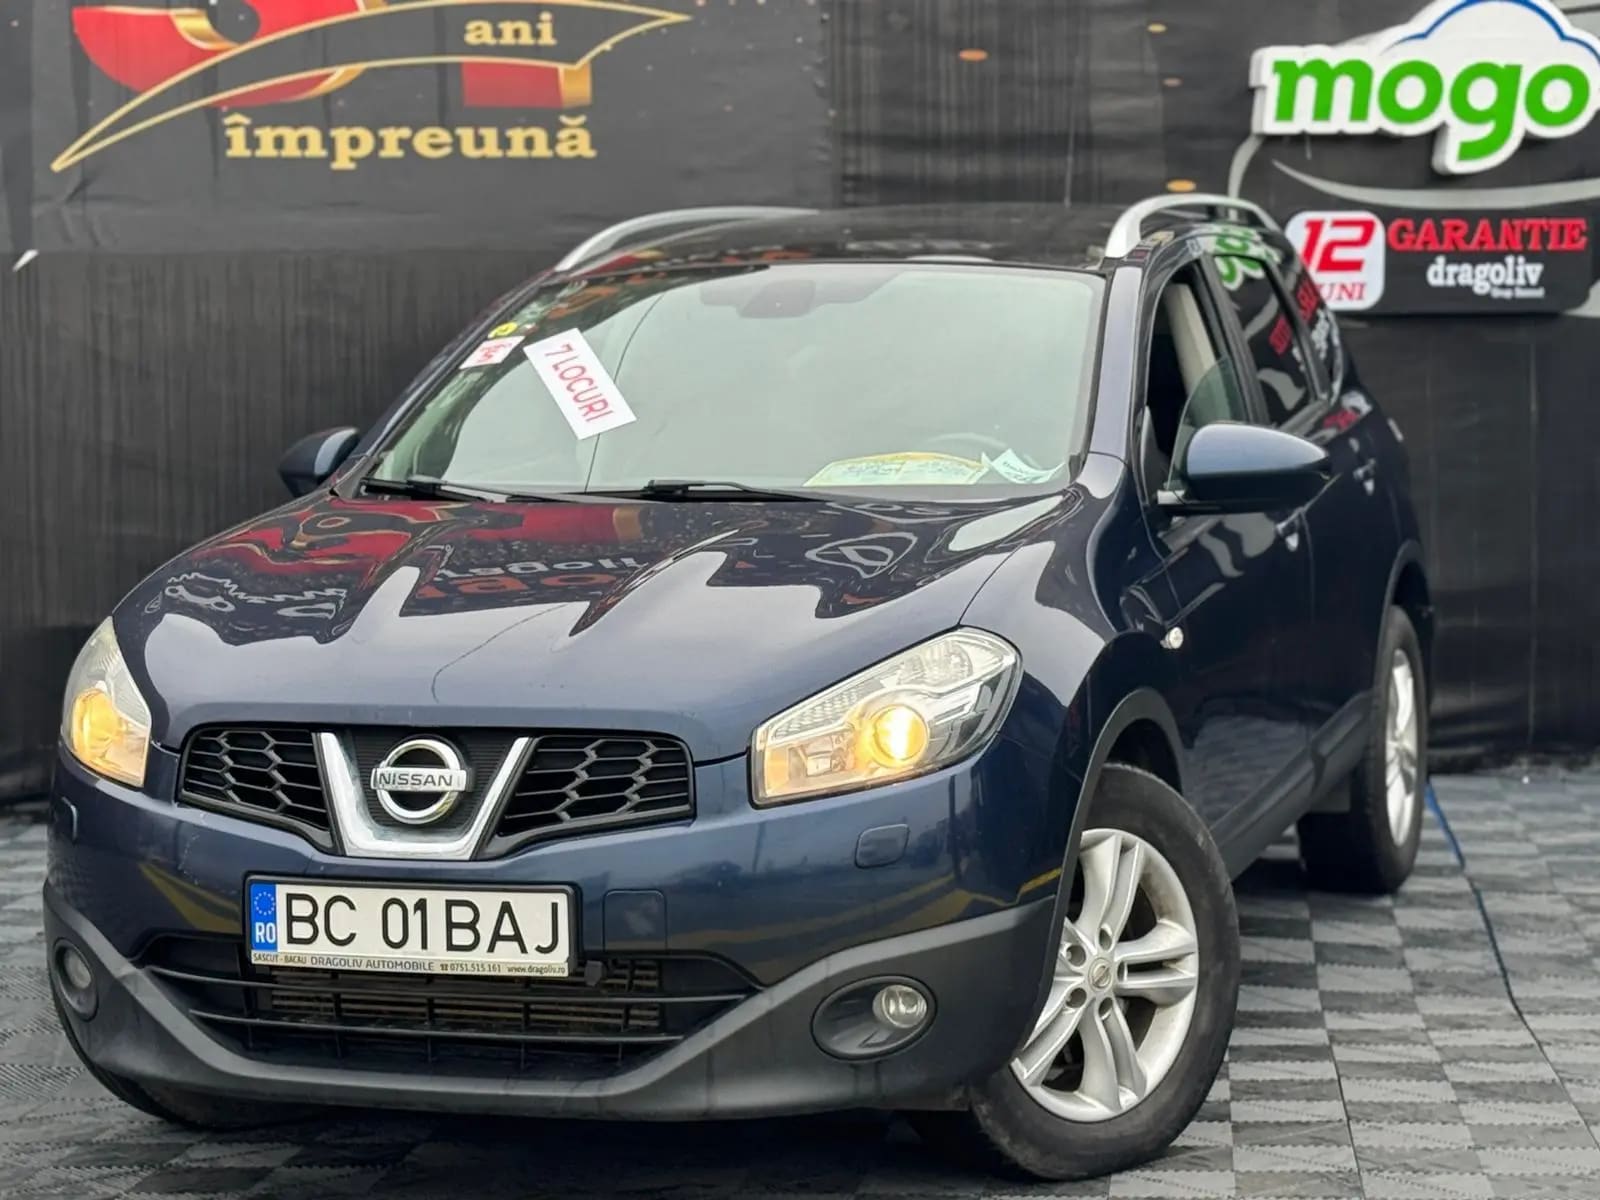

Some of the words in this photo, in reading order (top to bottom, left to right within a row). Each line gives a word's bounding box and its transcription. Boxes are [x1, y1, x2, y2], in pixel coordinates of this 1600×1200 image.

[464, 13, 557, 46] ani
[1272, 59, 1590, 162] mogo
[225, 114, 596, 170] împreună
[1303, 219, 1376, 272] 12
[1386, 218, 1588, 251] GARANTIE
[1315, 282, 1367, 301] UNI
[1426, 255, 1545, 295] dragoliv
[545, 343, 574, 357] 7
[551, 355, 614, 422] LOCURI
[379, 773, 453, 787] NISSAN
[255, 921, 277, 945] RO
[286, 892, 358, 947] BC
[381, 897, 429, 951] 01
[445, 899, 559, 955] BAJ
[253, 953, 279, 963] SASCUT
[310, 956, 363, 969] DRAGOLIV
[365, 959, 435, 972] AUTOMOBILE
